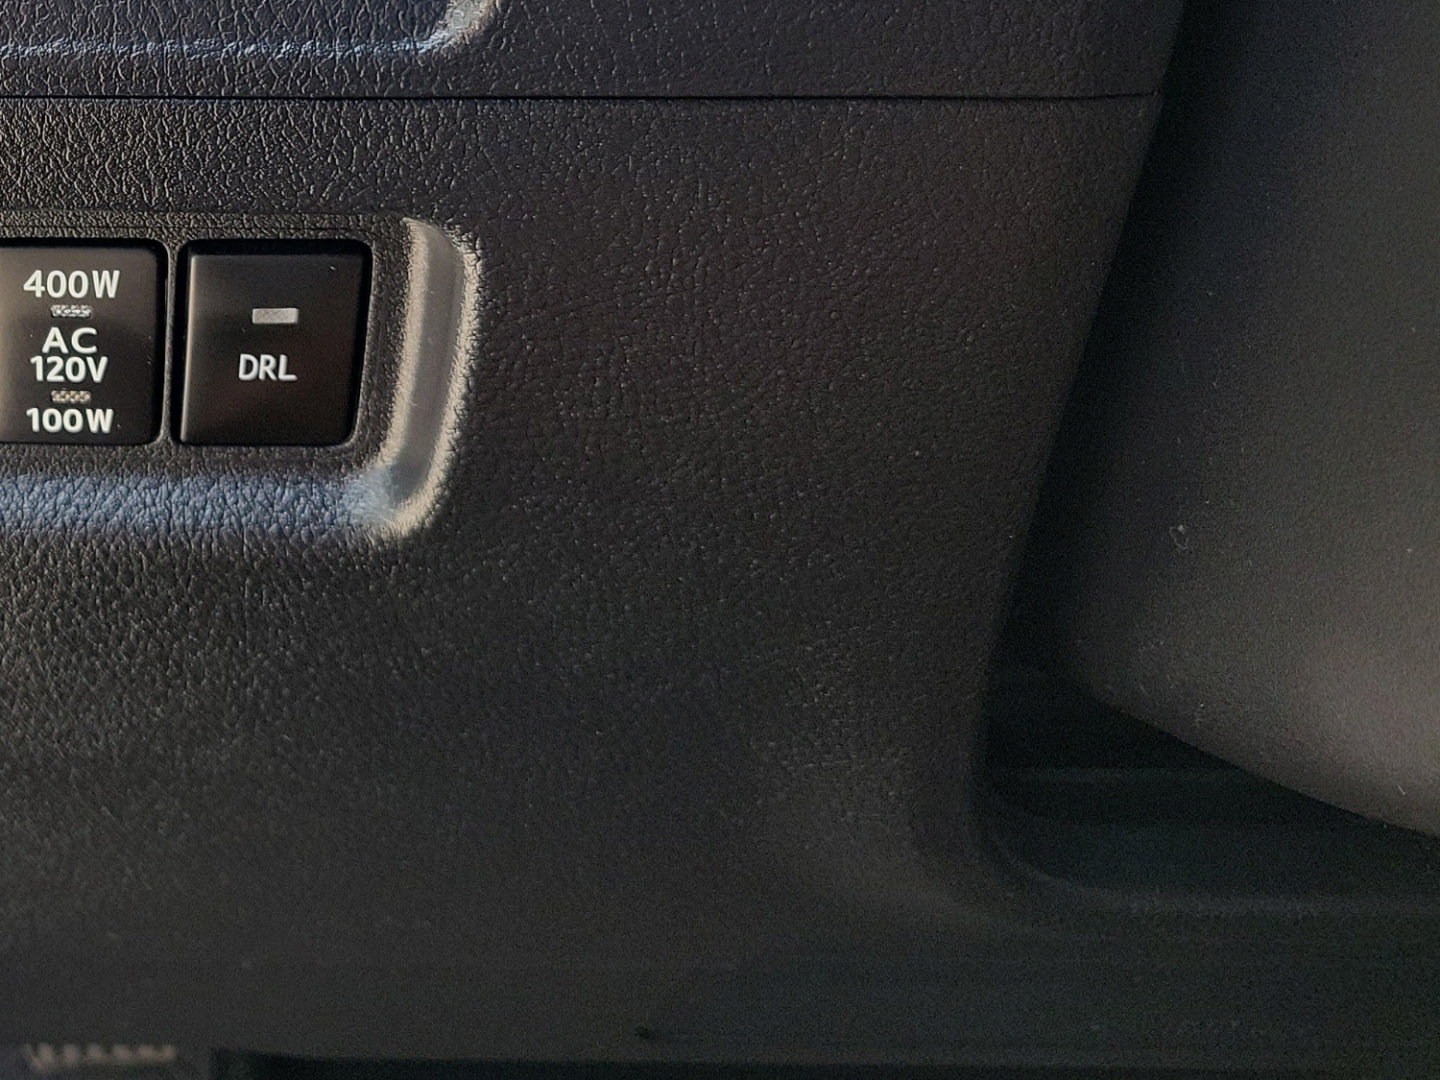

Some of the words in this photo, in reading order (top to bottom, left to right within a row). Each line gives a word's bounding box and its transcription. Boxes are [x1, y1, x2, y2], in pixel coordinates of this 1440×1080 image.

[23, 270, 120, 299] 400W
[41, 326, 98, 354] AC
[30, 356, 108, 383] 120V
[238, 353, 298, 381] DRL
[26, 407, 114, 434] 100W
